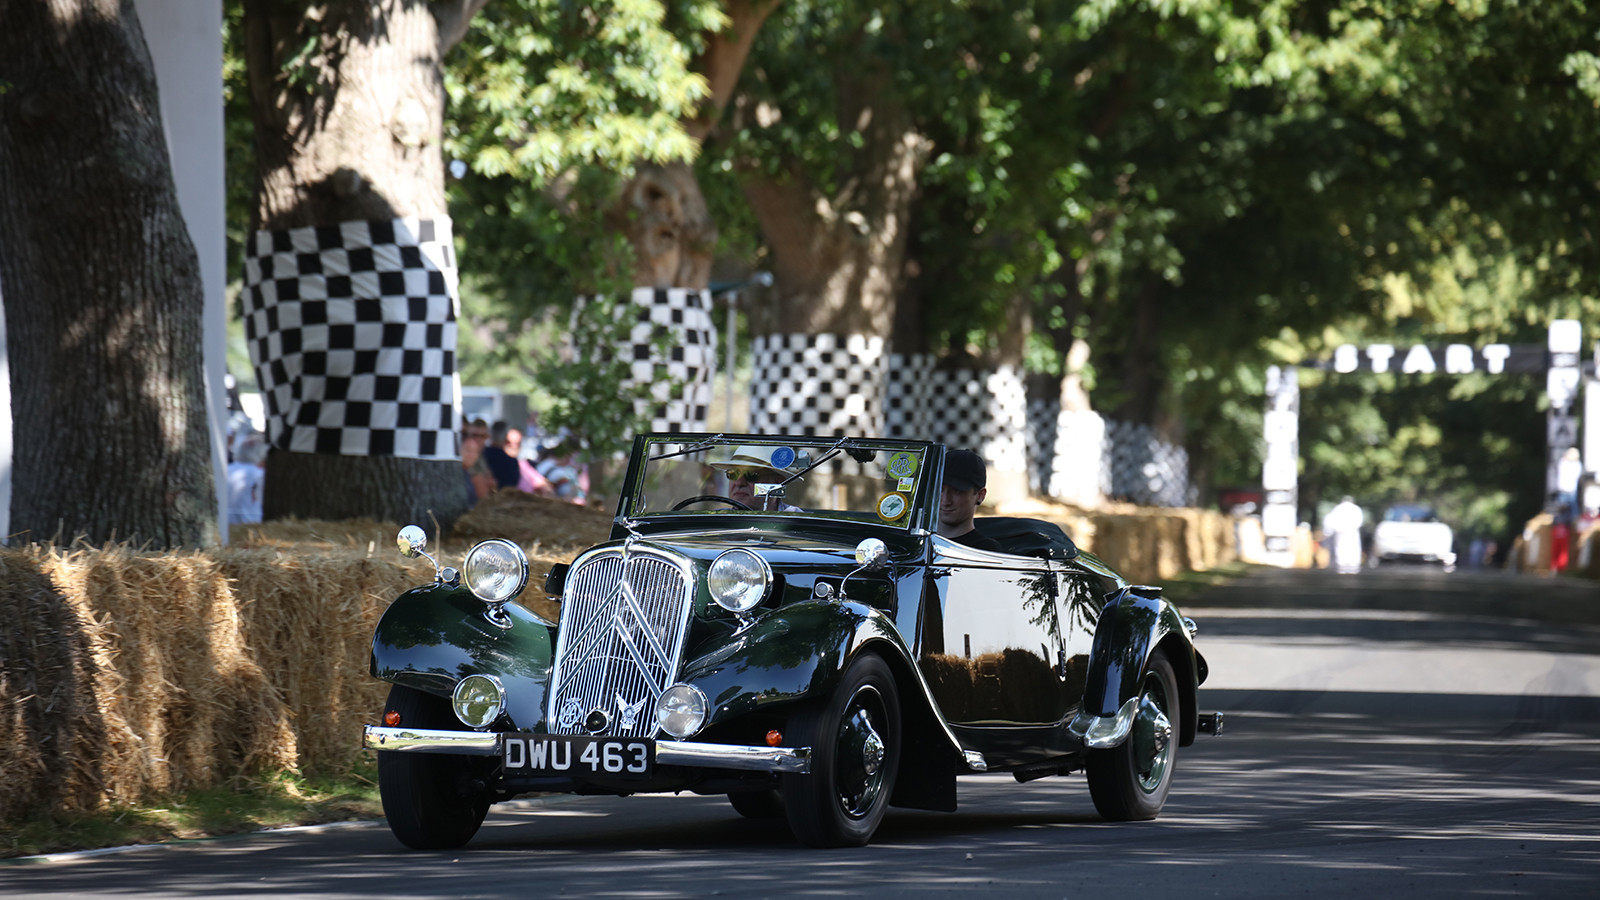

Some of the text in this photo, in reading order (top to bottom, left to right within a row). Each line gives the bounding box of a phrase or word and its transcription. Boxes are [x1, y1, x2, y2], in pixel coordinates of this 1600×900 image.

[1334, 344, 1511, 374] START
[505, 738, 648, 773] DWU 463
